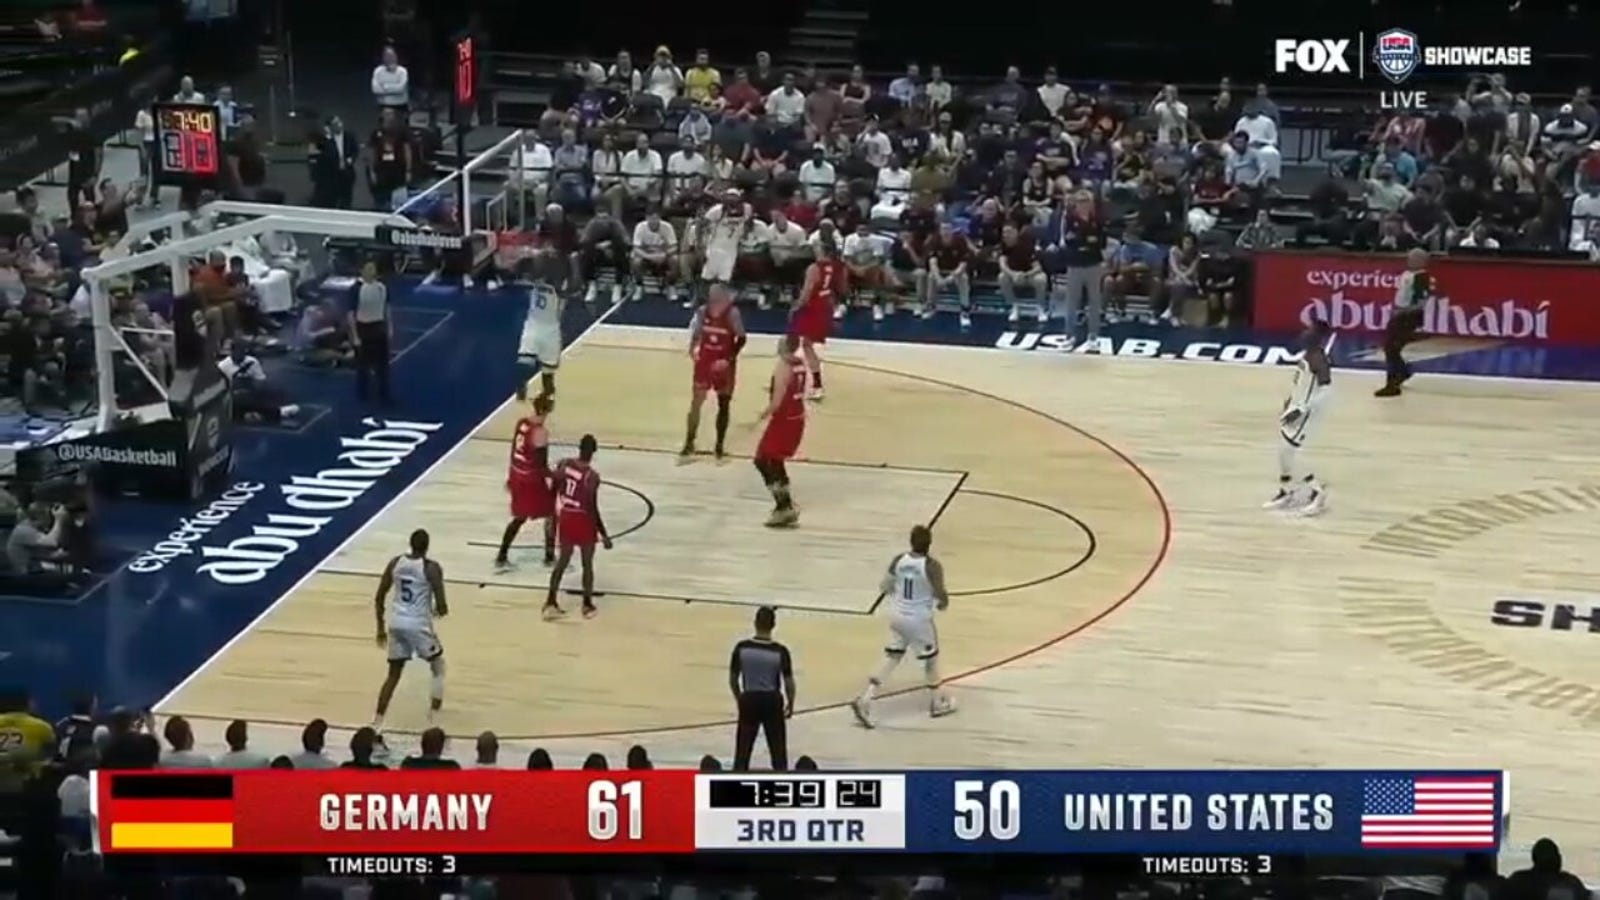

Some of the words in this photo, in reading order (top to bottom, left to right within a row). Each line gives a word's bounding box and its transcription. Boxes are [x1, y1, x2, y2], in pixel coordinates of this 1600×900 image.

[173, 111, 212, 133] 7:40
[1300, 290, 1393, 330] abu
[995, 332, 1308, 365] USAB.COM
[58, 443, 177, 467] @USABasketball
[196, 513, 333, 584] abu
[401, 579, 413, 603] 5
[904, 577, 913, 600] 11
